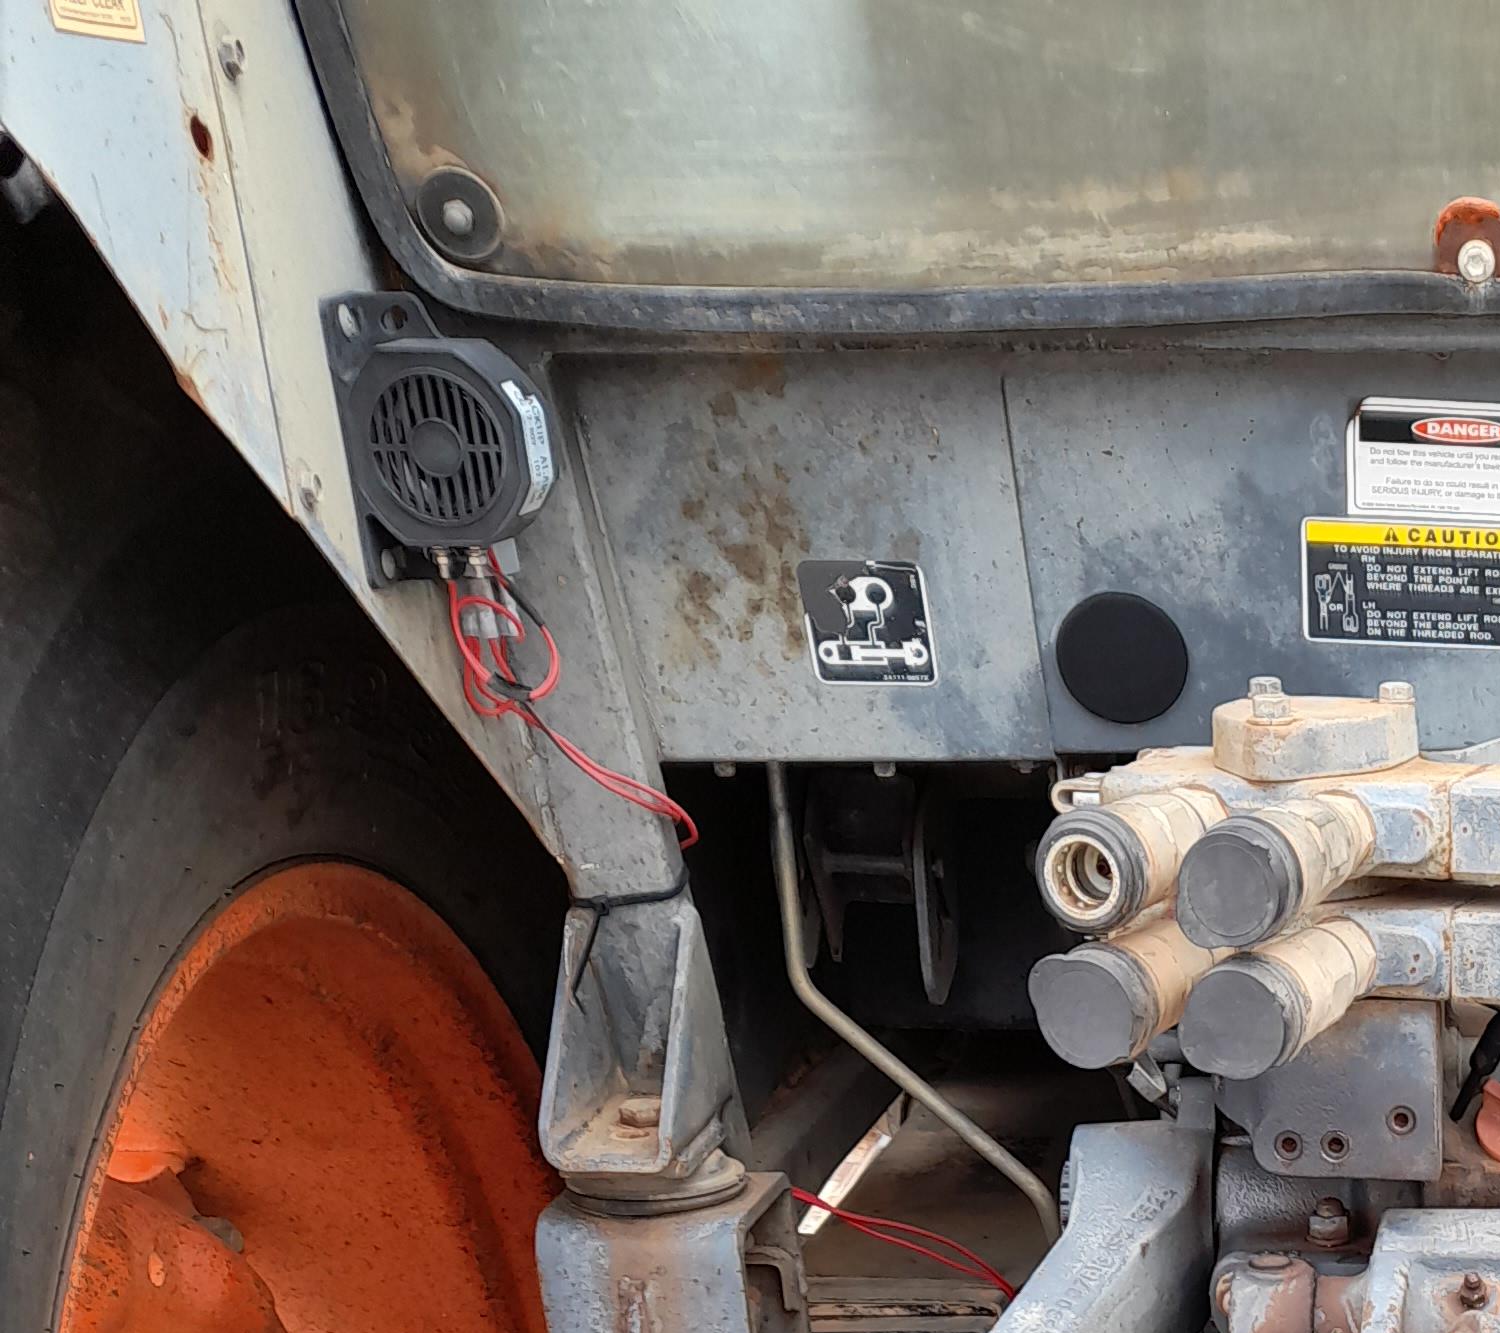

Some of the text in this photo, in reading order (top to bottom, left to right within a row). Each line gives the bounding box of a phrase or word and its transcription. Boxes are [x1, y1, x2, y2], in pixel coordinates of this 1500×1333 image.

[1426, 422, 1500, 437] DANGER
[1334, 544, 1348, 553] TO
[1350, 545, 1380, 554] AVOID
[1383, 547, 1420, 556] INJURY
[1422, 548, 1452, 557] FROM
[1361, 555, 1376, 563] RH
[1366, 564, 1381, 572] DO
[1387, 565, 1408, 573] NOT
[1413, 566, 1453, 575] EXTEND
[1459, 568, 1480, 577] LIFT
[1366, 572, 1469, 585] BEYOND THE POINT
[1367, 582, 1402, 591] WHERE
[1408, 583, 1454, 593] THREADS
[1460, 586, 1480, 594] ARE
[1329, 603, 1344, 612] OR
[1362, 601, 1376, 609] LH
[1367, 610, 1381, 618] DO
[1387, 611, 1408, 619] NOT
[1412, 612, 1452, 621] EXTEND
[1457, 613, 1478, 622] LIFT
[1367, 619, 1479, 631] BEYOND THE GROOVE
[1367, 627, 1495, 640] ON THE THREADED ROD.
